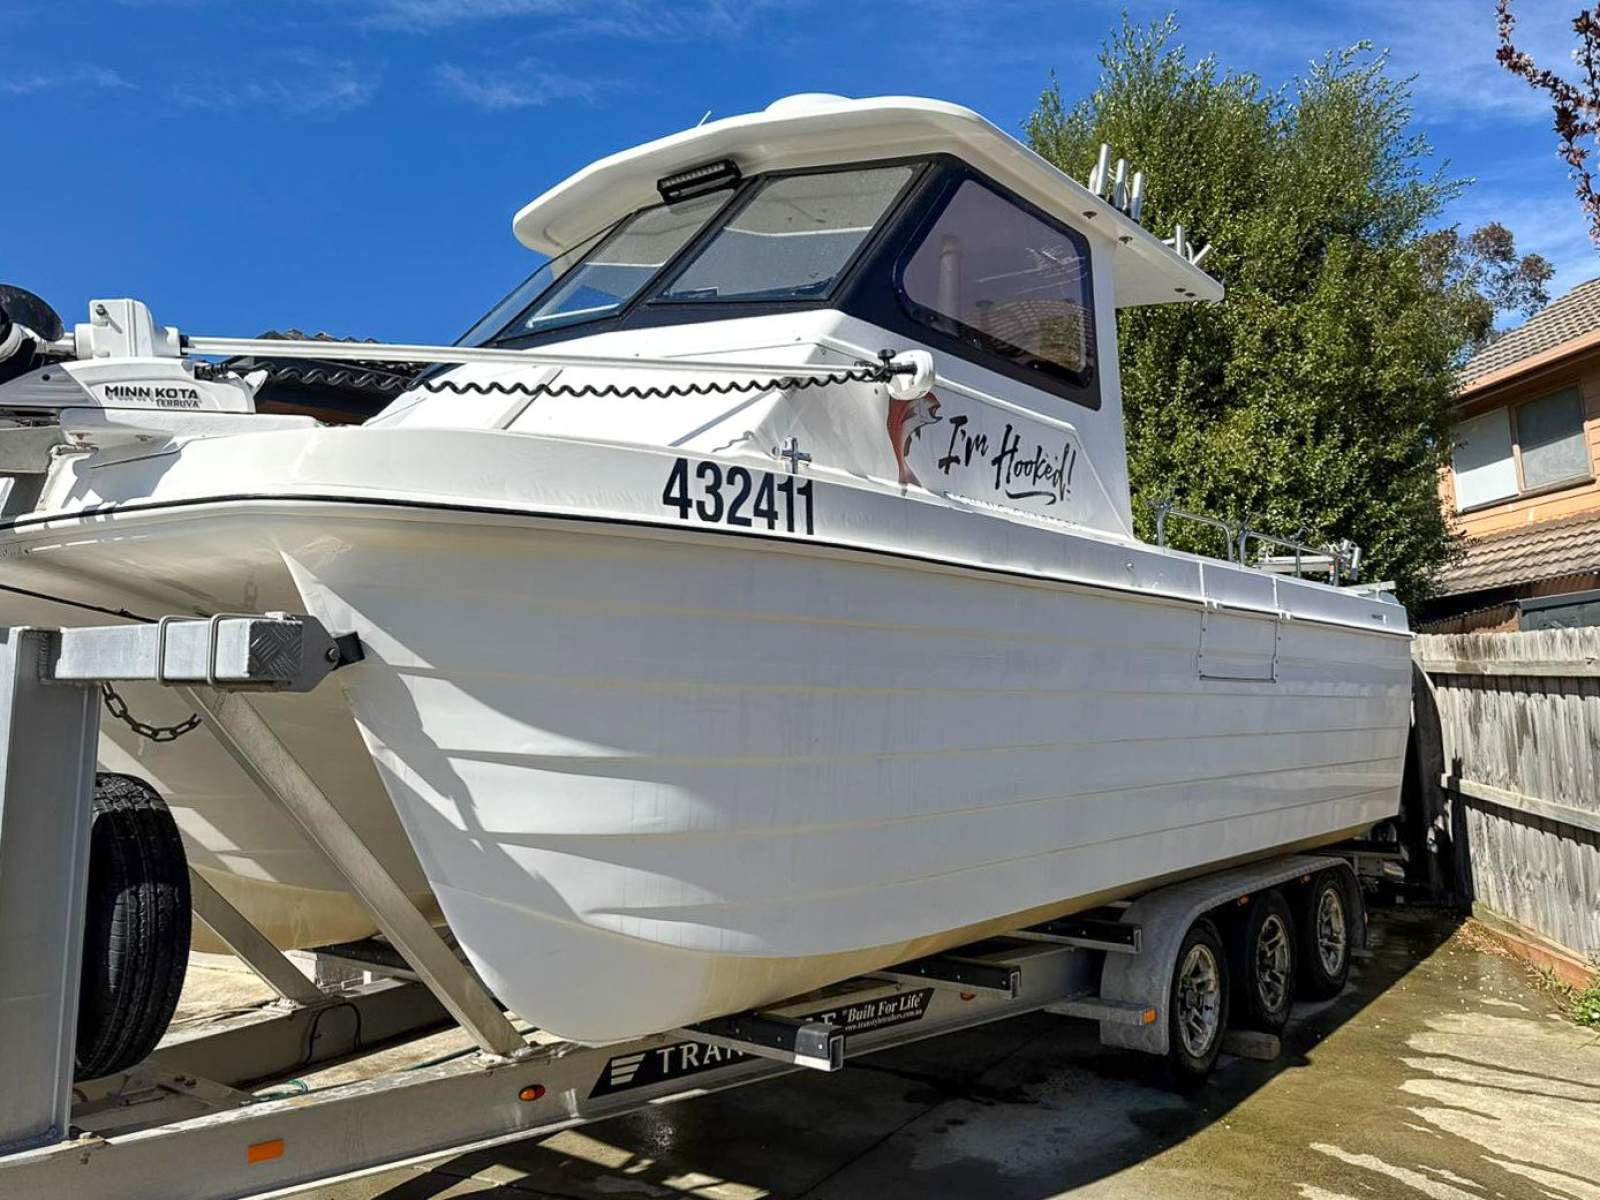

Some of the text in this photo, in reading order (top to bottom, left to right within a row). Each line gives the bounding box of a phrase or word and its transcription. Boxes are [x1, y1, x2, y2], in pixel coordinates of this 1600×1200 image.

[104, 385, 199, 400] MINN KOTA
[938, 415, 989, 475] I'm
[662, 457, 815, 535] 432411
[878, 1000, 898, 1016] For
